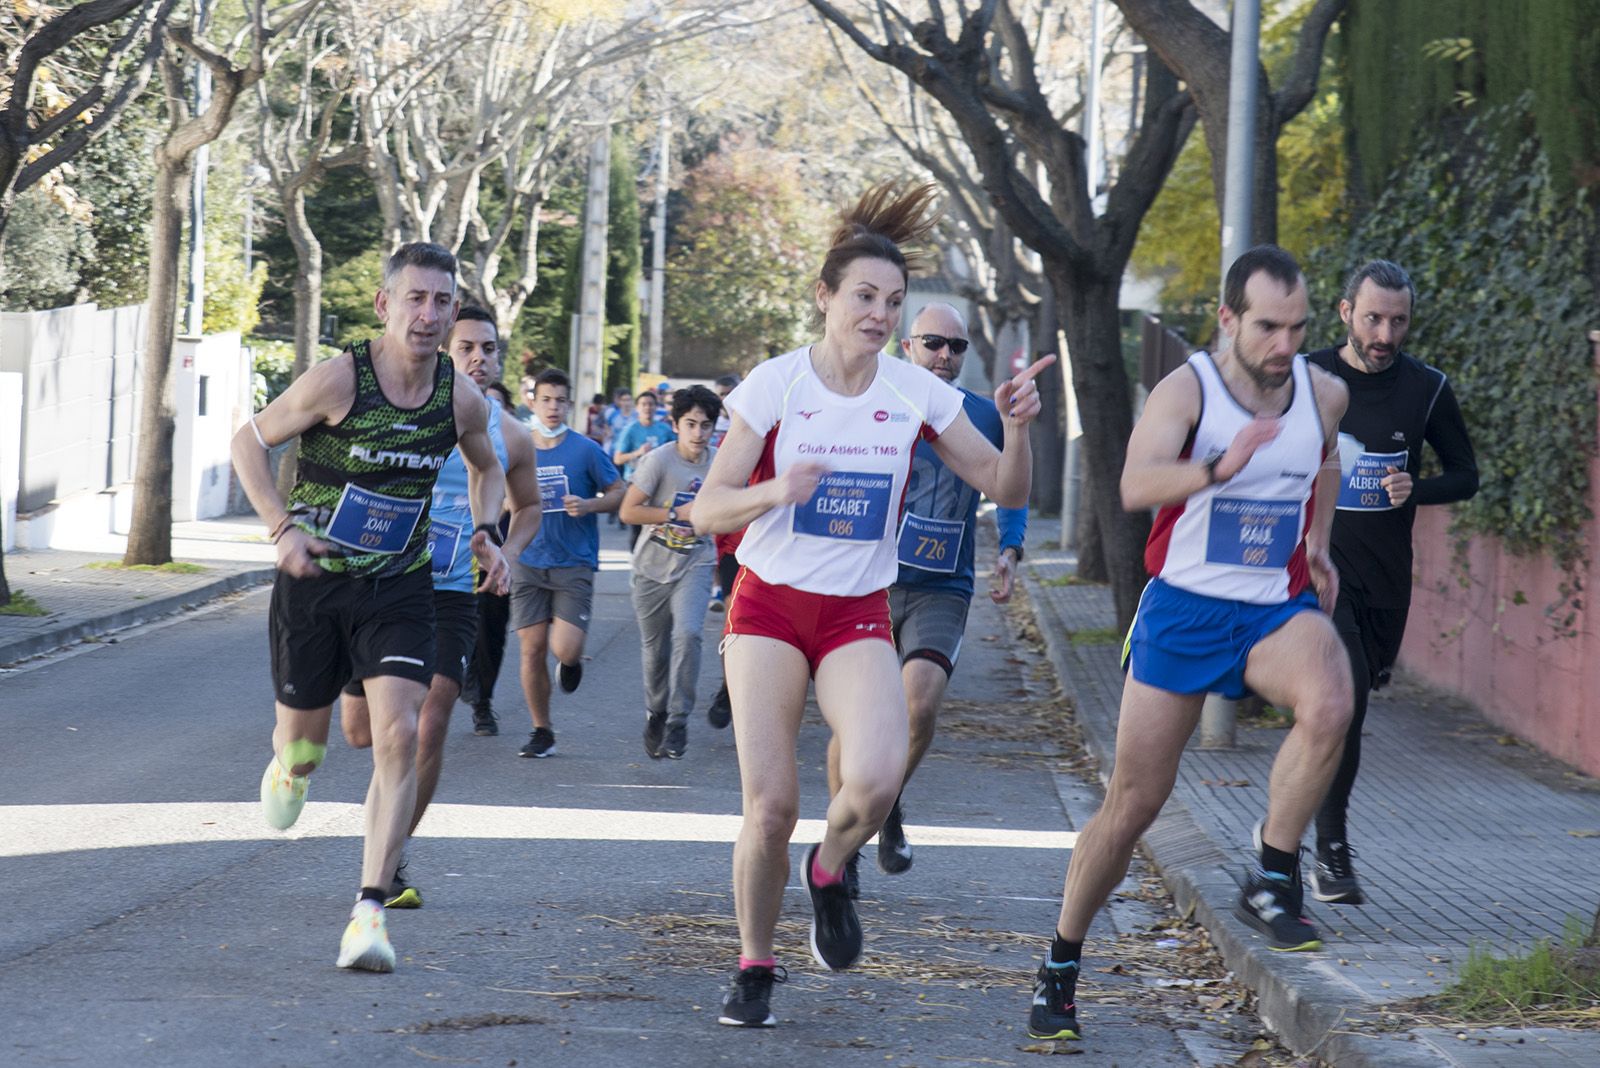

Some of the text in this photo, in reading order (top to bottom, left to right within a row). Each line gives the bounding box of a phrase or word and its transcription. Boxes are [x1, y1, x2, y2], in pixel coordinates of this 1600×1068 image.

[349, 445, 445, 470] RUNTEAM
[798, 443, 826, 455] Club
[871, 445, 898, 456] TMB
[816, 496, 871, 517] ELISABET
[1360, 493, 1380, 506] 052
[363, 517, 392, 533] JOAN
[828, 518, 853, 536] 086
[360, 532, 382, 547] 029
[914, 535, 948, 561] 726
[1242, 546, 1268, 566] 085
